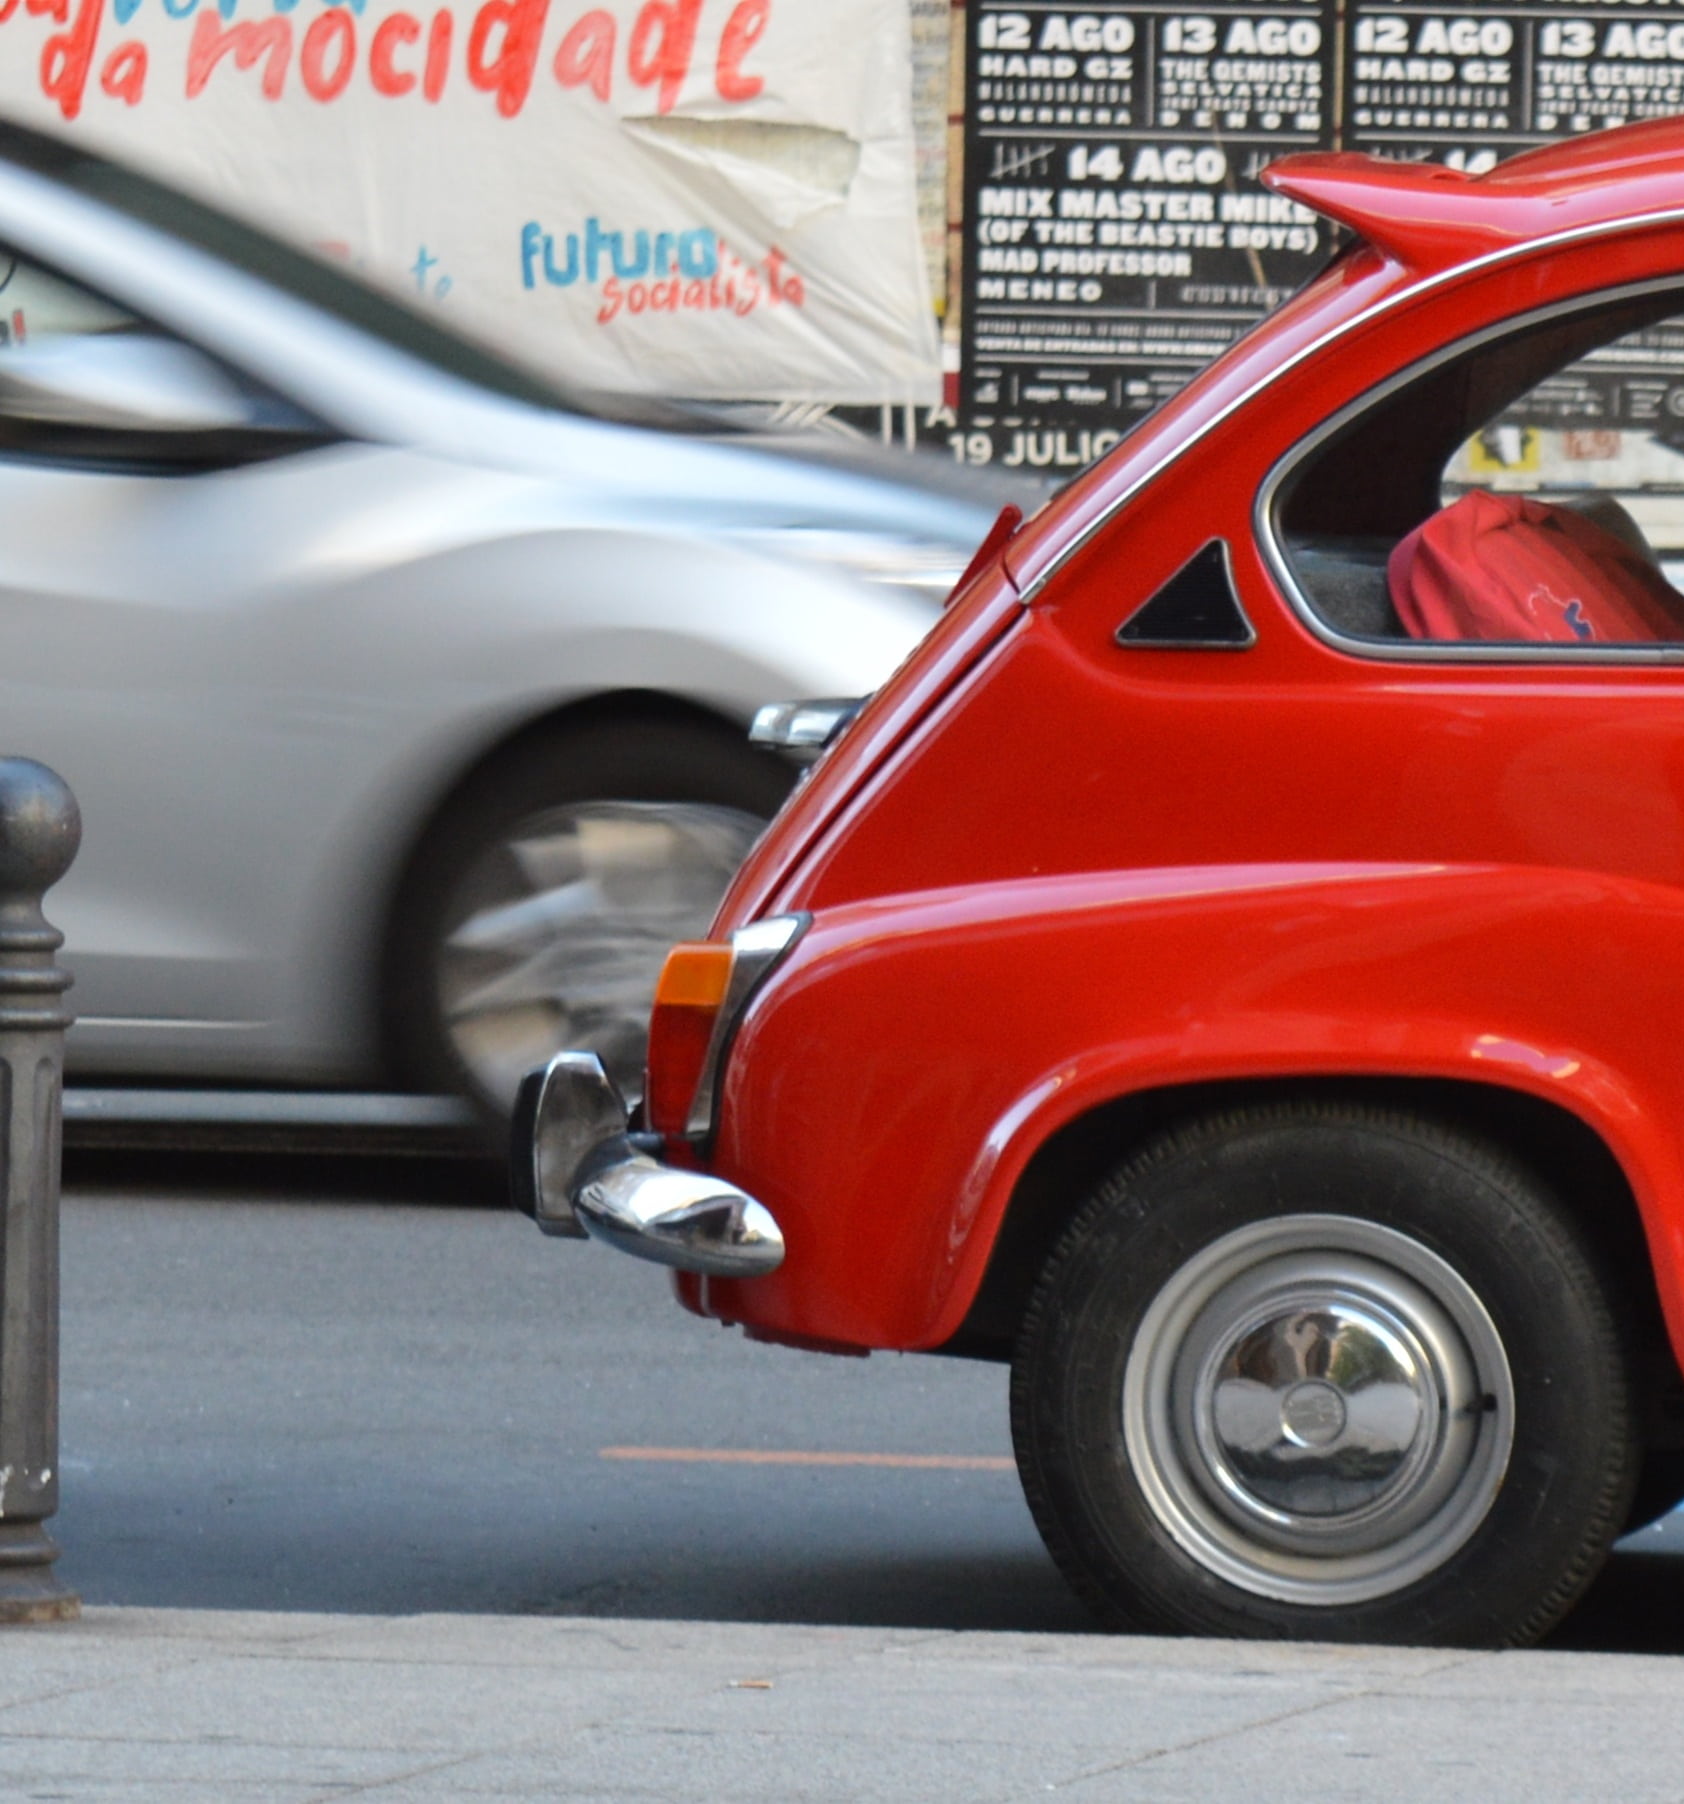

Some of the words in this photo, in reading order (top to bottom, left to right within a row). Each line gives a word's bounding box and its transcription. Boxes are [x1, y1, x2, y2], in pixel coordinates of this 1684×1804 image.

[978, 13, 1031, 49] 12
[1039, 16, 1135, 52] AGO
[1164, 18, 1217, 53] 13
[1226, 19, 1322, 56] AGO
[1355, 18, 1409, 53] 12
[1416, 18, 1514, 56] AGO
[1541, 21, 1596, 57] 13
[40, 0, 148, 121] da
[185, 0, 774, 118] mocidade
[978, 55, 1078, 78] HARD
[1159, 58, 1209, 81] THE
[1355, 58, 1455, 81] HARD
[1537, 62, 1588, 85] THE
[1068, 145, 1123, 181] 14
[1131, 148, 1227, 184] AGO
[978, 188, 1053, 218] MIX
[1059, 189, 1214, 221] MASTER
[1220, 192, 1317, 224] MIKE
[978, 218, 1029, 246] (OF
[1034, 220, 1093, 245] THE
[1098, 223, 1225, 248] BEASTIE
[1229, 225, 1319, 254] BOYS)
[978, 248, 1038, 273] MAD
[1042, 250, 1192, 276] PROFESSOR
[595, 239, 805, 325] socialista
[977, 279, 1102, 302] MENEO
[948, 432, 993, 465] 19
